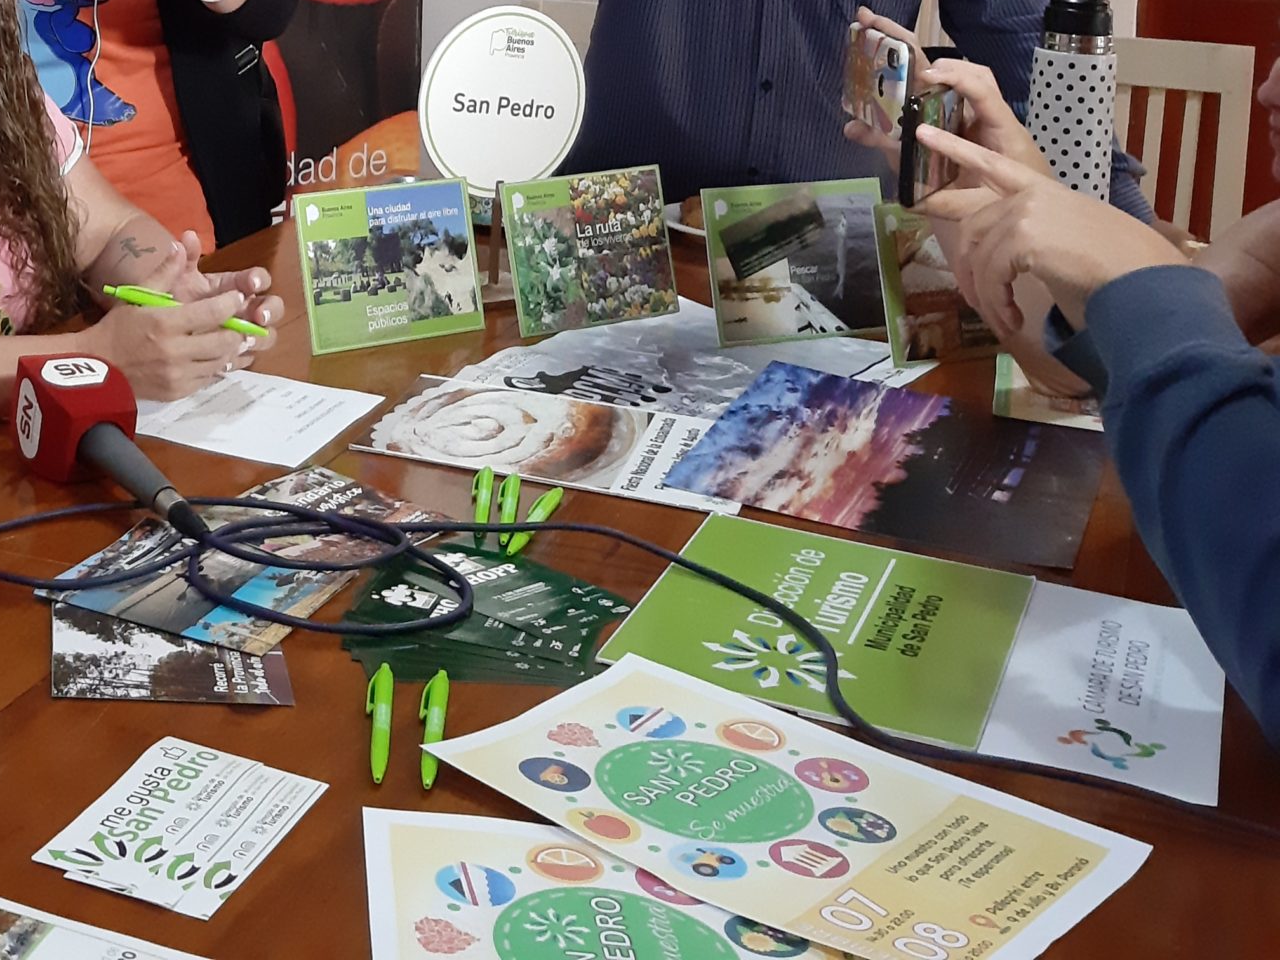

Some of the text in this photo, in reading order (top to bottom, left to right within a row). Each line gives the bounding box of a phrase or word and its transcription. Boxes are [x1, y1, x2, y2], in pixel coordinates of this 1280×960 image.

[505, 44, 526, 54] Aires
[506, 36, 535, 46] Buenos
[452, 92, 556, 120] San Pedro
[349, 143, 387, 179] de
[367, 202, 411, 216] Una ciudad
[368, 217, 386, 228] para
[387, 212, 418, 224] disfrutar
[442, 207, 459, 217] libre
[575, 219, 622, 238] La ruta
[591, 235, 605, 246] los
[365, 301, 409, 318] Espacios
[368, 316, 409, 333] públicos
[53, 361, 98, 377] SN
[19, 394, 36, 440] SN
[631, 453, 656, 477] Nacional
[263, 478, 347, 518] Cndario
[747, 548, 826, 628] Dicción de
[863, 583, 917, 652] Municipalidad
[896, 593, 944, 658] de San Pedro
[209, 662, 230, 693] Recorré
[229, 650, 249, 694] la Provincia
[1078, 619, 1123, 714] CÁMARA DE TURISMO
[1118, 639, 1150, 707] DE SAN PEDRO
[99, 765, 174, 830] me gusta
[107, 749, 220, 844] San Pedro
[197, 779, 226, 803] Turismo
[623, 774, 681, 807] SAN
[674, 757, 760, 808] PEDRO
[226, 795, 254, 820] Turismo
[262, 805, 290, 827] Turismo
[689, 773, 796, 841] Se muestra
[885, 858, 908, 876] Una
[904, 836, 940, 865] muestra
[928, 849, 950, 867] San
[942, 834, 971, 857] Pedro
[819, 887, 890, 932] 07
[892, 921, 971, 960] 08
